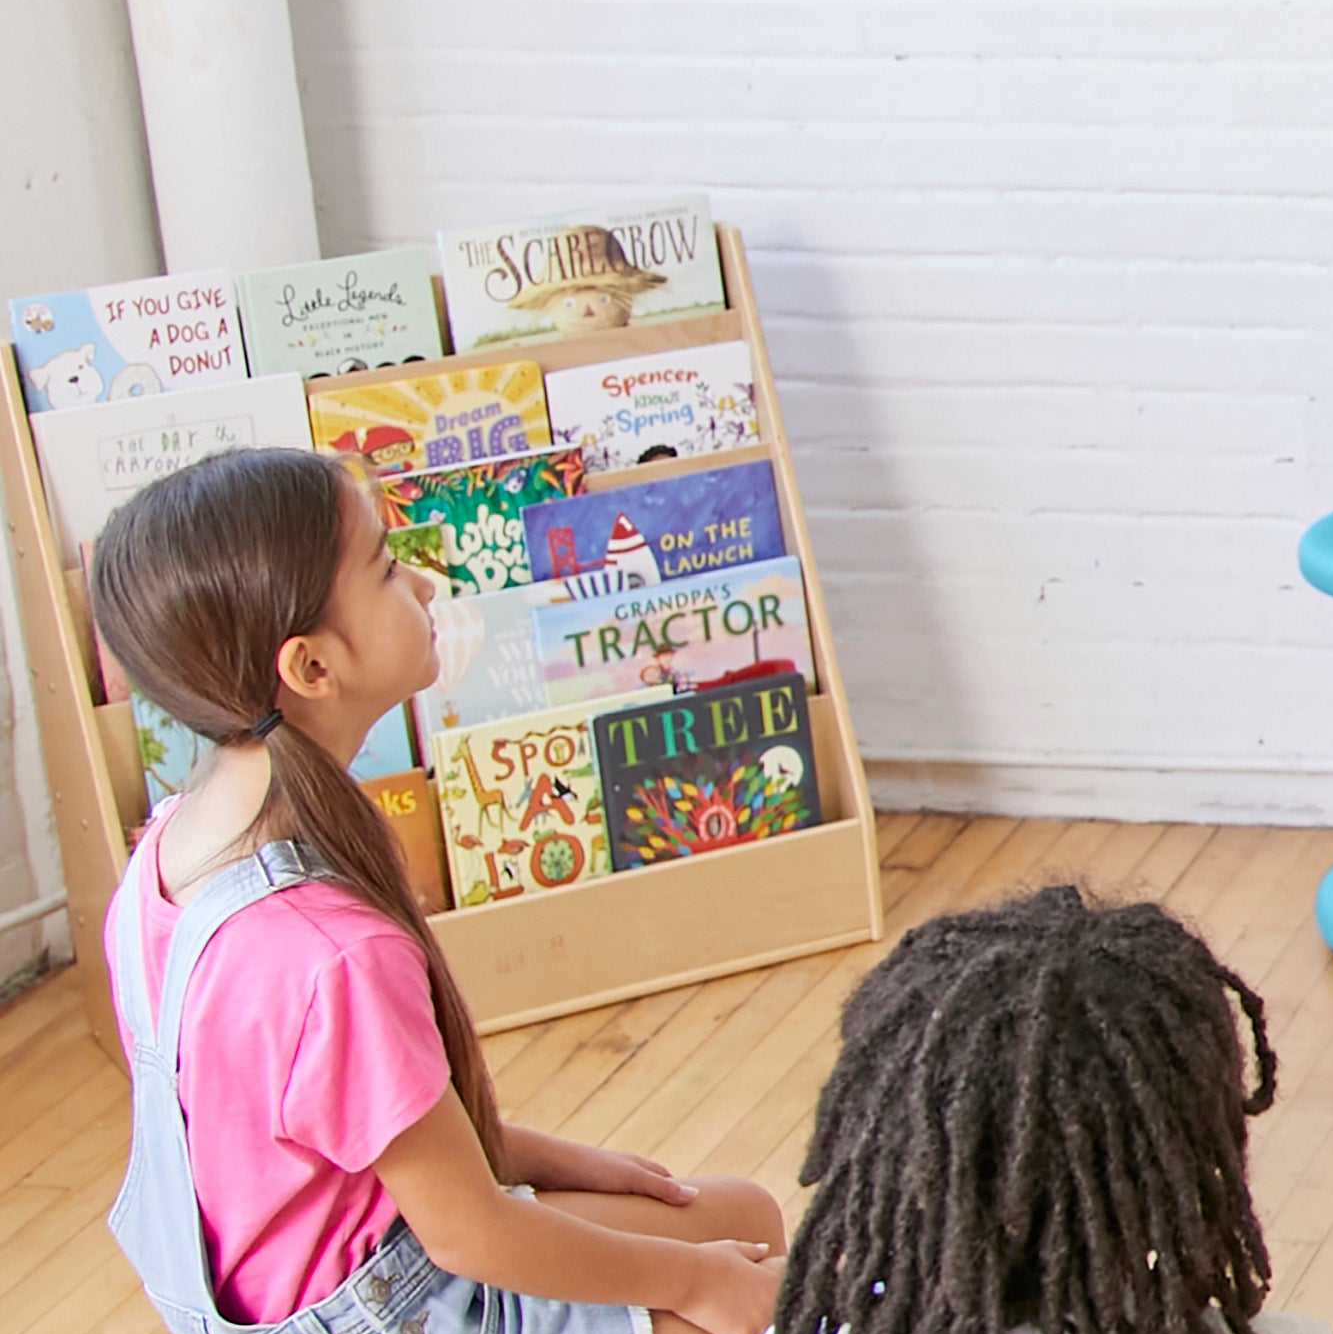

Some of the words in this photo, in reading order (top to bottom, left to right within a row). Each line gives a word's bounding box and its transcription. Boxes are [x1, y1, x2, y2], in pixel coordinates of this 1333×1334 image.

[459, 239, 494, 268] THE
[484, 214, 699, 303] SCARECROW
[105, 298, 126, 324] IF
[131, 294, 171, 318] YOU
[176, 287, 227, 312] GIVE
[275, 283, 336, 328] Little
[337, 270, 408, 312] Legends
[149, 327, 161, 350] A
[166, 322, 210, 345] DOG
[216, 317, 229, 338] A
[168, 344, 233, 376] DONUT
[601, 368, 699, 398] Spencer
[434, 402, 502, 434] Dream
[615, 404, 695, 436] Spring
[116, 437, 145, 453] THE
[160, 430, 199, 452] DAY
[425, 415, 530, 468] BIG
[659, 530, 694, 552] ON
[703, 517, 752, 544] THE
[663, 543, 754, 577] LAUNCH
[614, 582, 732, 621] GRANDPA'S
[564, 593, 785, 669] TRACTOR
[606, 685, 799, 768] TREE
[372, 788, 418, 817] ks
[519, 773, 575, 832] A
